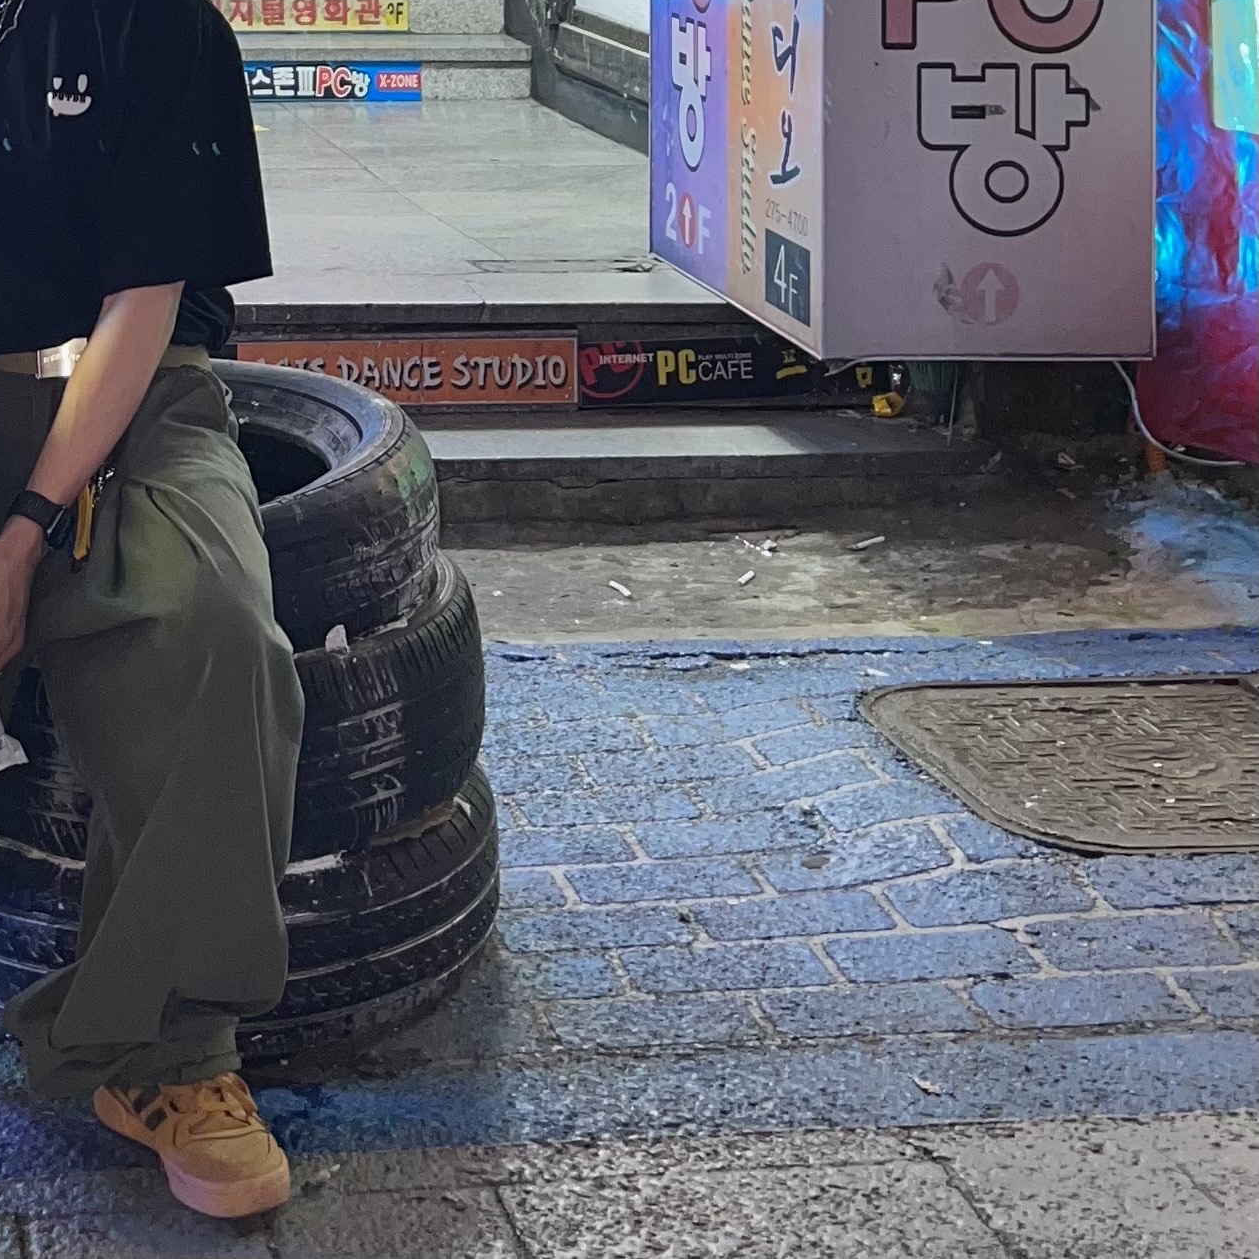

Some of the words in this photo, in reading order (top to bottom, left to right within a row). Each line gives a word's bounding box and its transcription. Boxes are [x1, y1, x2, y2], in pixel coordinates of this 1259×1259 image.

[379, 73, 419, 88] X-ZONE
[774, 244, 799, 317] 4F
[337, 354, 443, 389] DANCE
[450, 353, 567, 388] STUDIO
[599, 351, 655, 365] INTERNET
[656, 348, 697, 387] PC
[698, 359, 754, 382] CAFE
